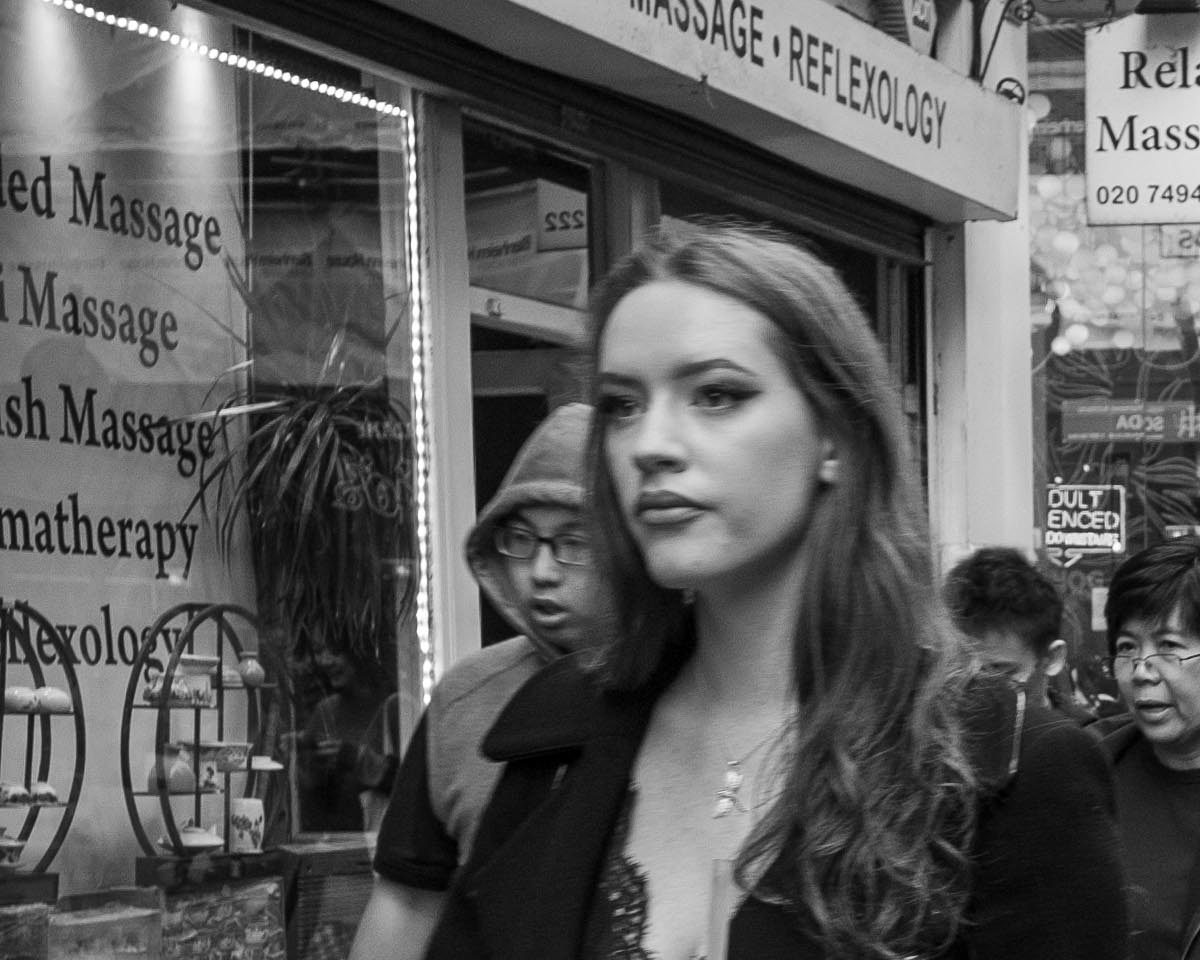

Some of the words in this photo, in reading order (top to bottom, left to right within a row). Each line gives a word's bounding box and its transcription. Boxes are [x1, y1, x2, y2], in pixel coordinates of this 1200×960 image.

[630, 0, 764, 67] SSAGE
[789, 25, 947, 149] REFLEXOLOGY
[68, 164, 222, 271] Massage
[1096, 185, 1139, 204] 020
[18, 264, 179, 368] Massage
[58, 383, 215, 478] Massage
[1047, 510, 1120, 530] ENCED
